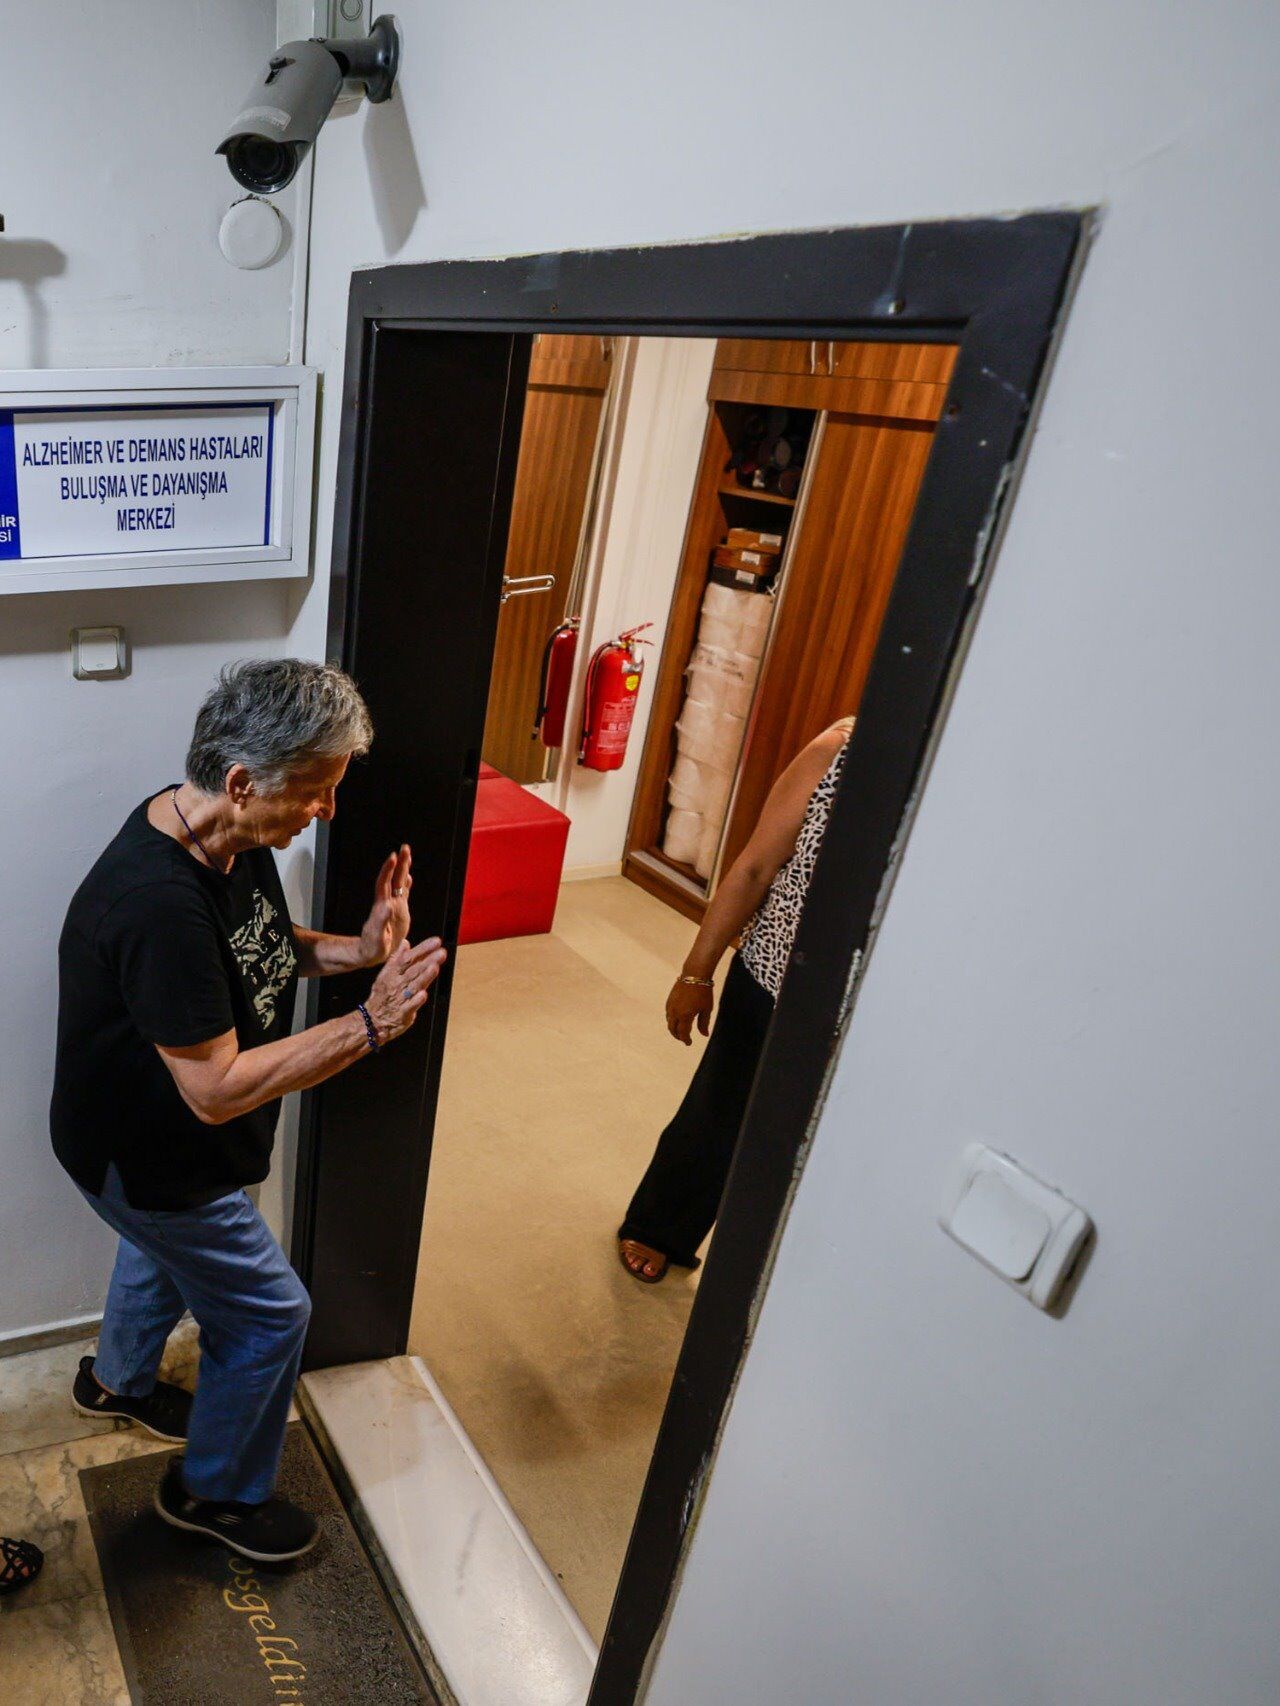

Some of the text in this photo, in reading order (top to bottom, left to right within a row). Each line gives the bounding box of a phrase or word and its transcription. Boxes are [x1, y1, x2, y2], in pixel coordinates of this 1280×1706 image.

[23, 435, 263, 467] ALZHEİMER VE DEMANS HASTALARI
[61, 471, 228, 505] BULUŞMA VE DAYANIŞMA
[117, 502, 175, 532] MERKEZİ
